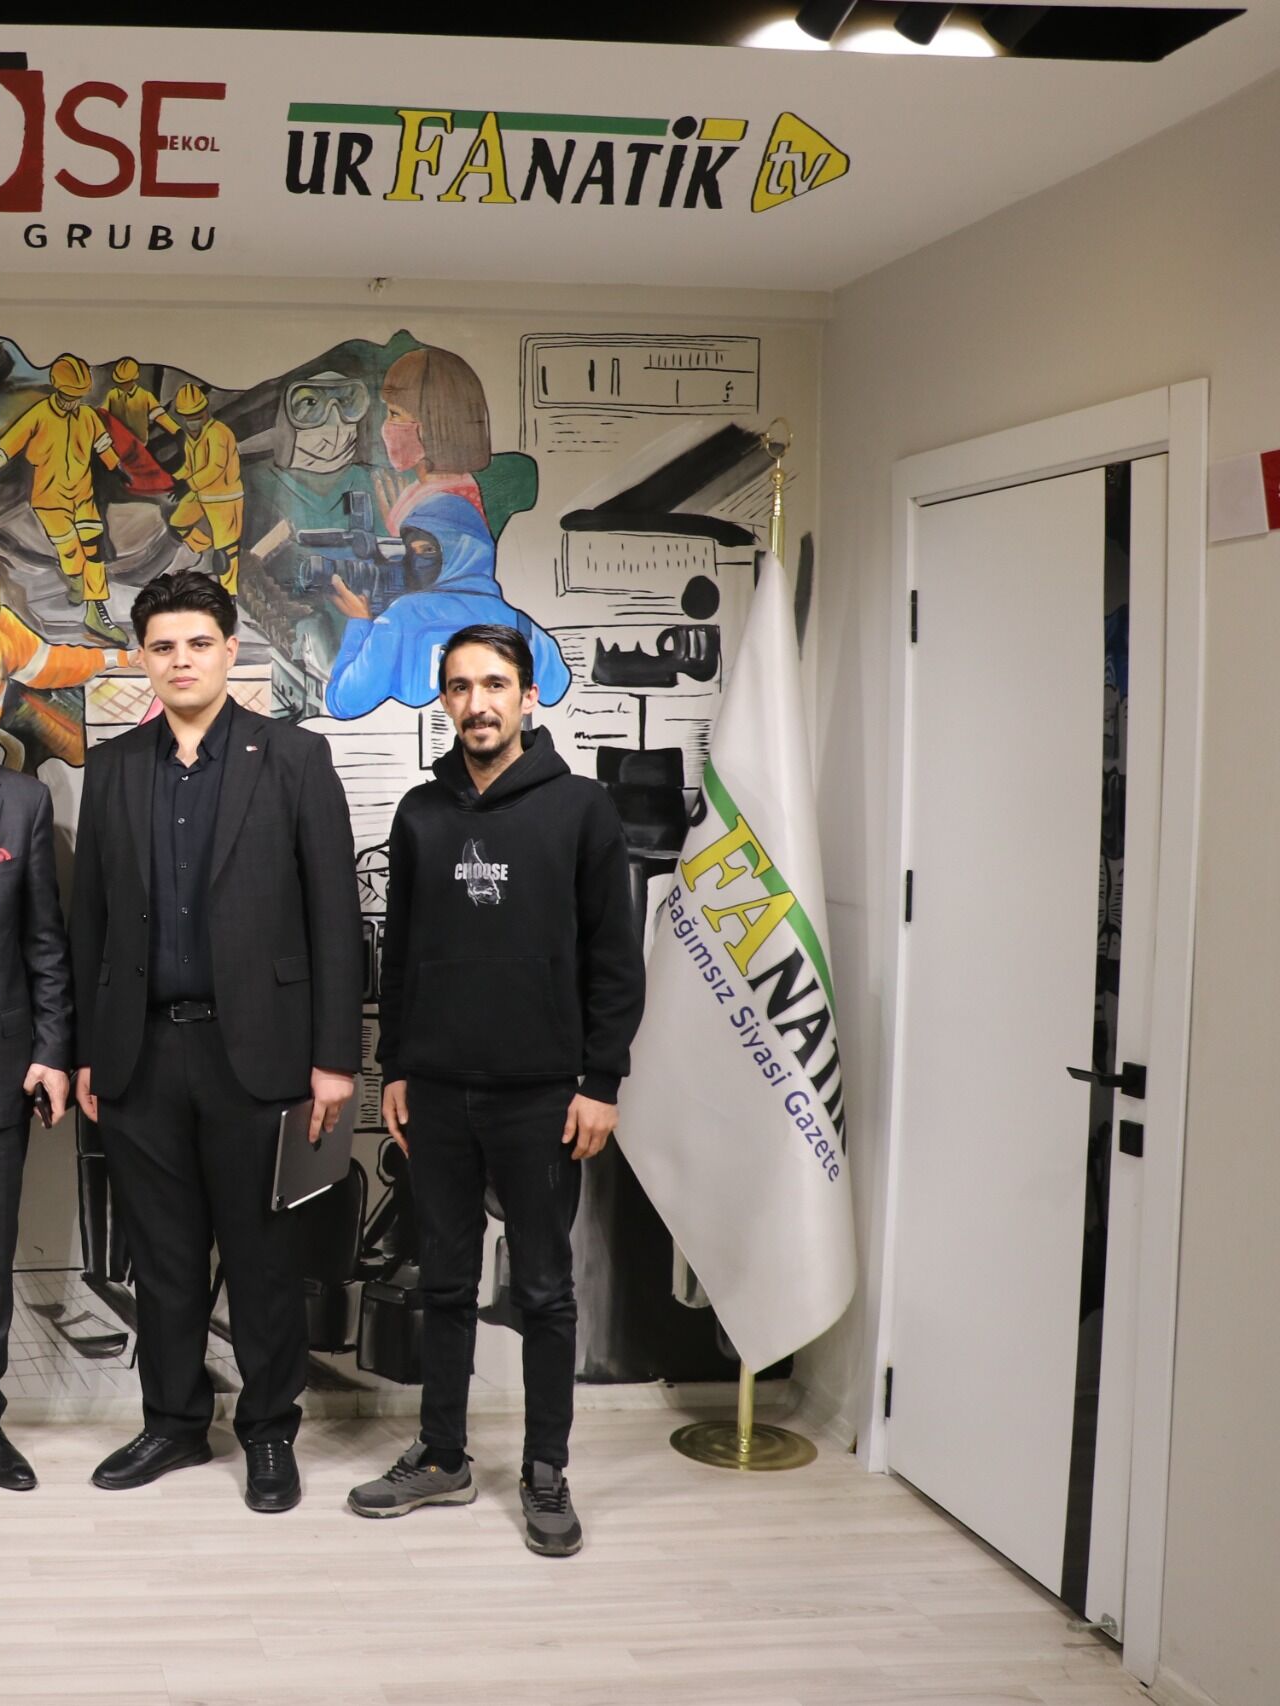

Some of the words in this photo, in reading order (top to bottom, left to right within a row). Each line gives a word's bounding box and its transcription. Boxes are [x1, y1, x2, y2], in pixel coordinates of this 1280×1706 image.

[168, 135, 220, 153] EKOL
[767, 140, 829, 197] tv
[24, 223, 216, 251] GRUBU
[454, 863, 508, 881] CHOOSE
[668, 885, 735, 1004] Bağımsız
[730, 1005, 792, 1087] Siyasi
[784, 1090, 840, 1182] Gazete
